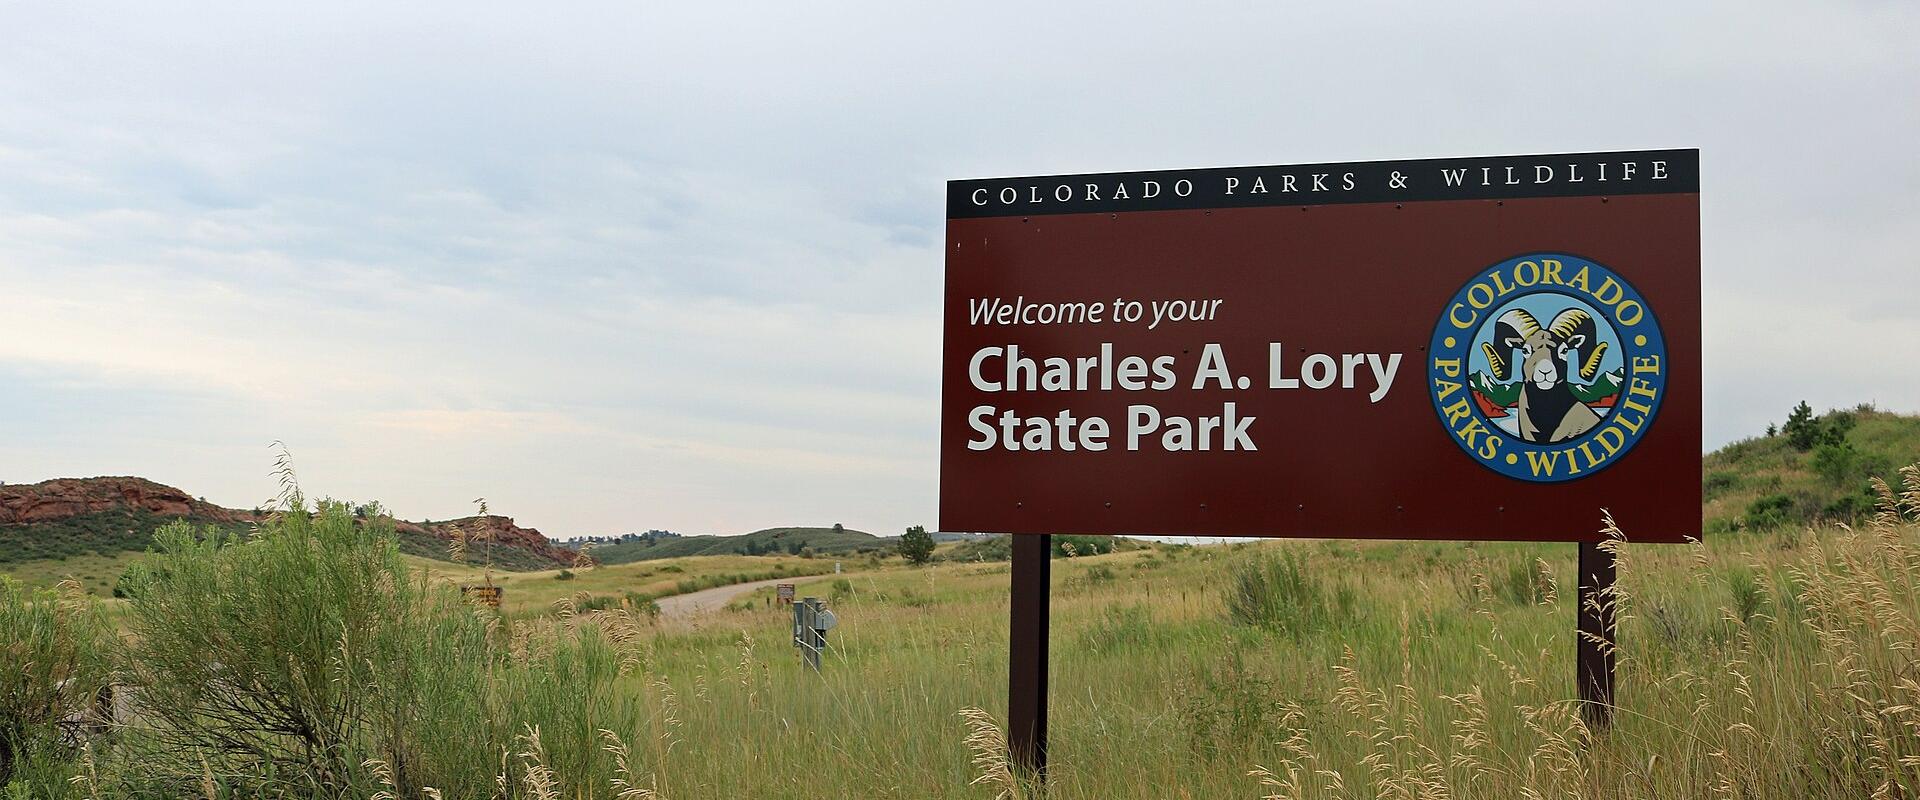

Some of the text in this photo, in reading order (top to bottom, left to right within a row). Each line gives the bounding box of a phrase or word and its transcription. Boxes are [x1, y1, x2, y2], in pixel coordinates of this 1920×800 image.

[971, 160, 1668, 206] COLORADO PARKS & WILDLIFE
[970, 295, 1223, 330] Welcome to your
[1449, 259, 1644, 329] COLORADO
[968, 342, 1403, 404] Charles A. Lory
[967, 402, 1258, 452] State Park
[1434, 353, 1660, 477] PARKS WILDLIFE
